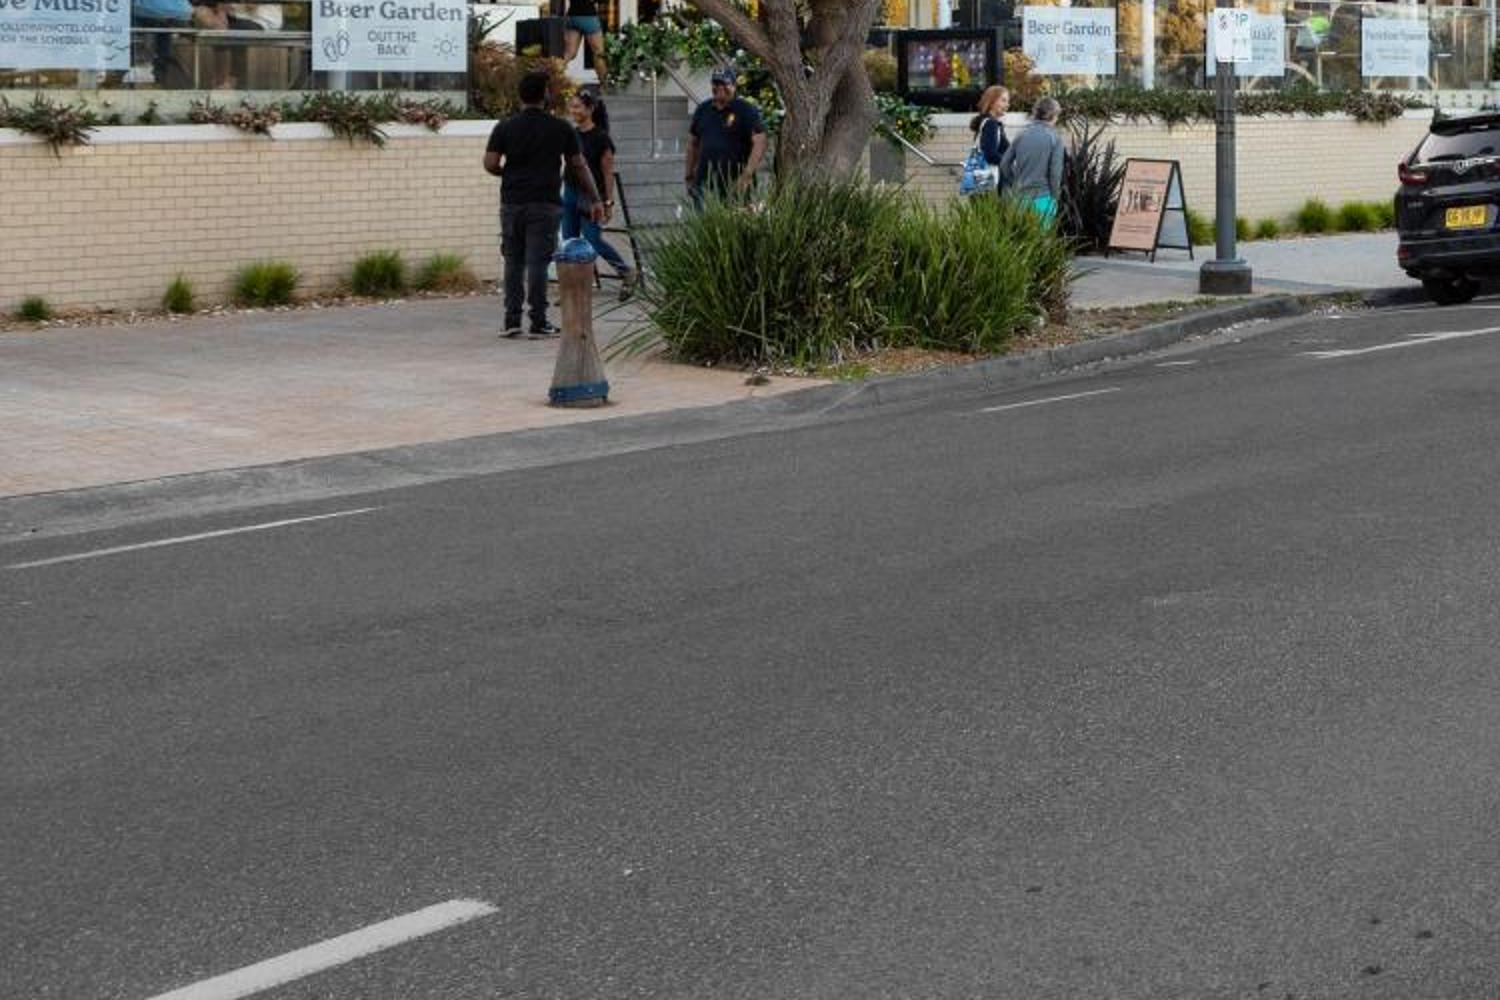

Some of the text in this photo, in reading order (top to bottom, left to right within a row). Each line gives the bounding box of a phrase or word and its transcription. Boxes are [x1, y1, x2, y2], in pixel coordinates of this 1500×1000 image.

[319, 0, 463, 21] Beer Garden
[1028, 19, 1111, 36] Beer Garden
[367, 29, 417, 43] OUT THE
[377, 43, 408, 56] BACK
